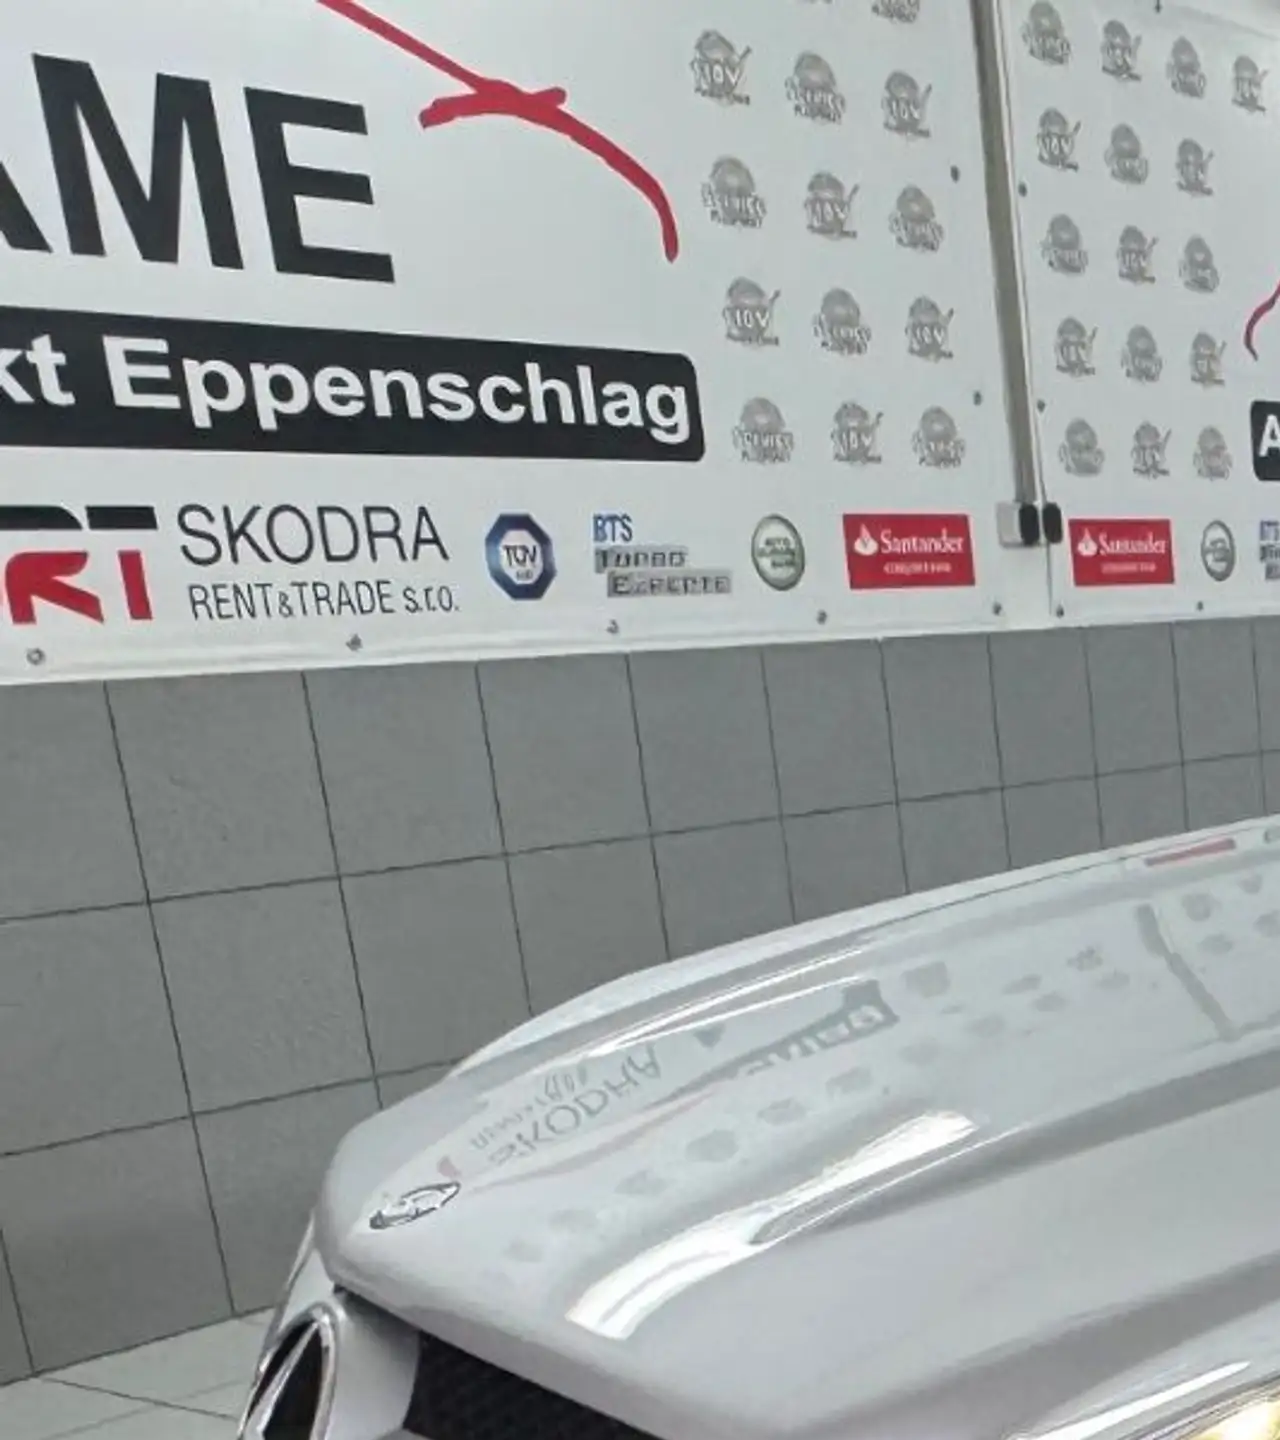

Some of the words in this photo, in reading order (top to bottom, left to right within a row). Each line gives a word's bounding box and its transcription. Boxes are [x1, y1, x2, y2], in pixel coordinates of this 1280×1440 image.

[102, 335, 689, 446] Eppenschlag
[176, 503, 450, 567] SKODRA
[592, 513, 633, 543] BTS
